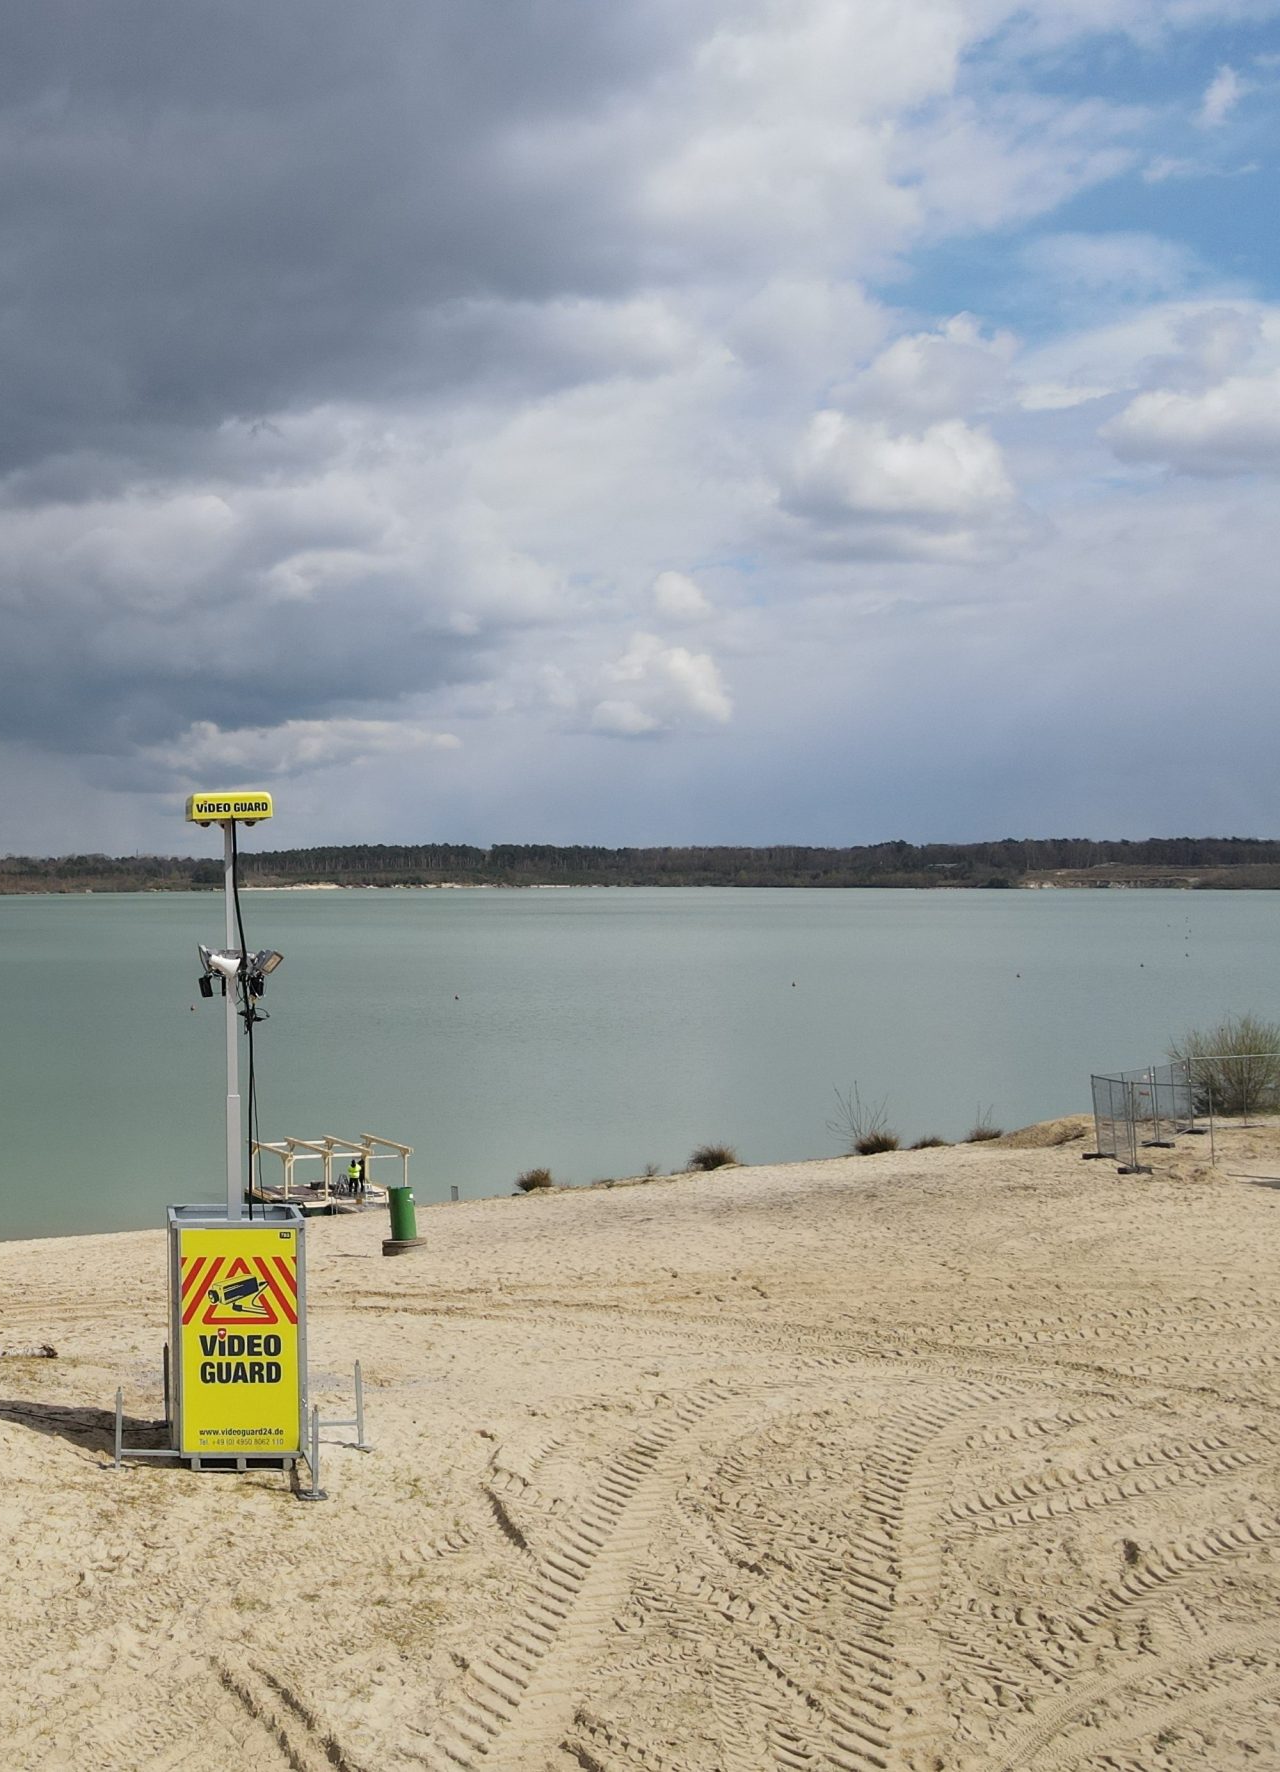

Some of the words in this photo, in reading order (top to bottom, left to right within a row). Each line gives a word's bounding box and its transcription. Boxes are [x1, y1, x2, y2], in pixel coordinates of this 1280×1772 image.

[234, 802, 268, 812] GUARD
[200, 1361, 282, 1384] GUARD
[199, 1428, 284, 1436] www.videoguard24.de
